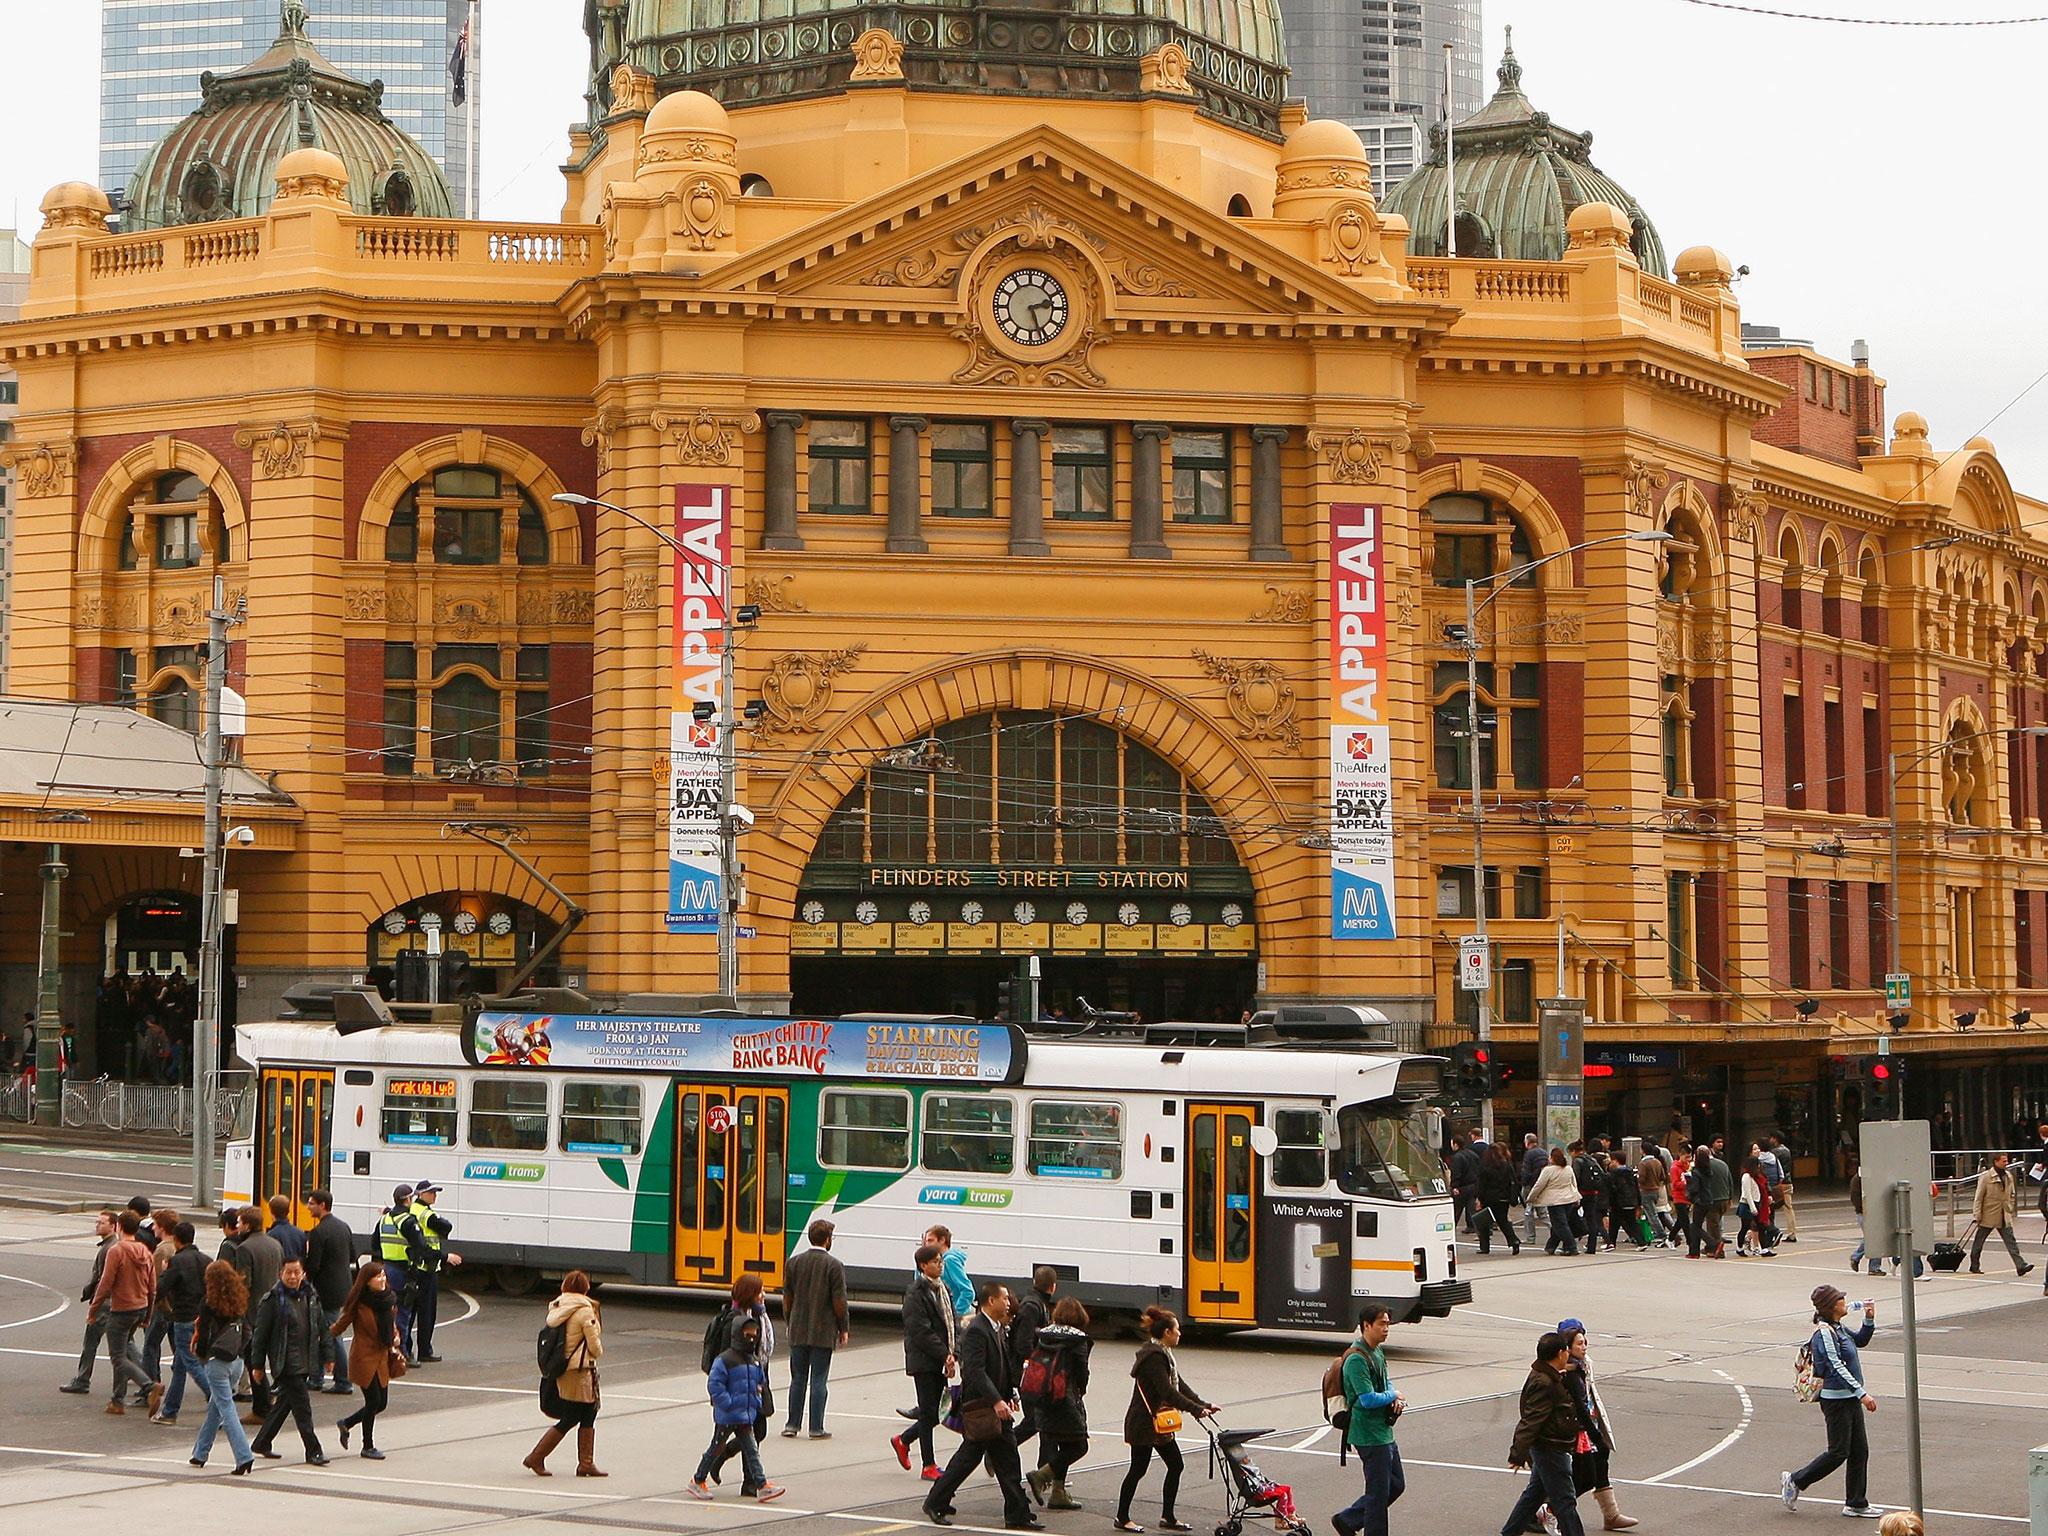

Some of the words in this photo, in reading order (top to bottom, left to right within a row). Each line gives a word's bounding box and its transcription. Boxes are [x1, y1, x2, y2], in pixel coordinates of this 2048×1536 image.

[682, 488, 722, 709] APPEAL
[1337, 508, 1377, 721] APPEAL
[676, 779, 722, 787] FATHER
[1336, 790, 1387, 798] FATHER'S
[1336, 799, 1387, 818] DAY
[1337, 820, 1387, 829] APPEAL
[677, 828, 703, 836] Donate
[1365, 838, 1386, 846] today
[871, 869, 971, 887] FLINDERS
[997, 870, 1072, 887] STREET
[1098, 871, 1188, 888] STATION
[666, 914, 696, 922] Swanston
[697, 914, 704, 922] St
[1343, 920, 1378, 929] METRO
[576, 1021, 597, 1031] HER
[599, 1021, 652, 1033] MAJESTY'S
[654, 1022, 702, 1033] THEATRE
[606, 1033, 635, 1043] FROM
[637, 1034, 648, 1044] 30
[649, 1034, 669, 1045] JAN
[733, 1031, 772, 1049] CHITTY
[775, 1021, 832, 1045] CHITTY
[866, 1025, 980, 1048] STARRING
[587, 1046, 611, 1055] BOOK
[613, 1047, 632, 1055] NOW
[635, 1047, 645, 1056] AT
[646, 1047, 688, 1057] TICKETEK
[866, 1045, 912, 1060] DAVID
[916, 1047, 979, 1063] HOBSON
[1628, 1053, 1657, 1063] Hatters
[593, 1057, 681, 1067] CHITTYCHITTY.COM.AU
[733, 1047, 773, 1069] BANG
[776, 1044, 827, 1074] BANG
[866, 1061, 876, 1073] &
[877, 1062, 938, 1075] RACHAEL
[417, 1081, 431, 1095] via
[710, 1110, 727, 1119] STOP
[470, 1164, 498, 1177] yarra
[508, 1166, 539, 1178] trams
[1432, 1178, 1447, 1193] 129
[925, 1189, 957, 1202] yarra
[970, 1190, 1006, 1203] trams
[1273, 1203, 1304, 1216] White
[1306, 1205, 1343, 1218] Awake
